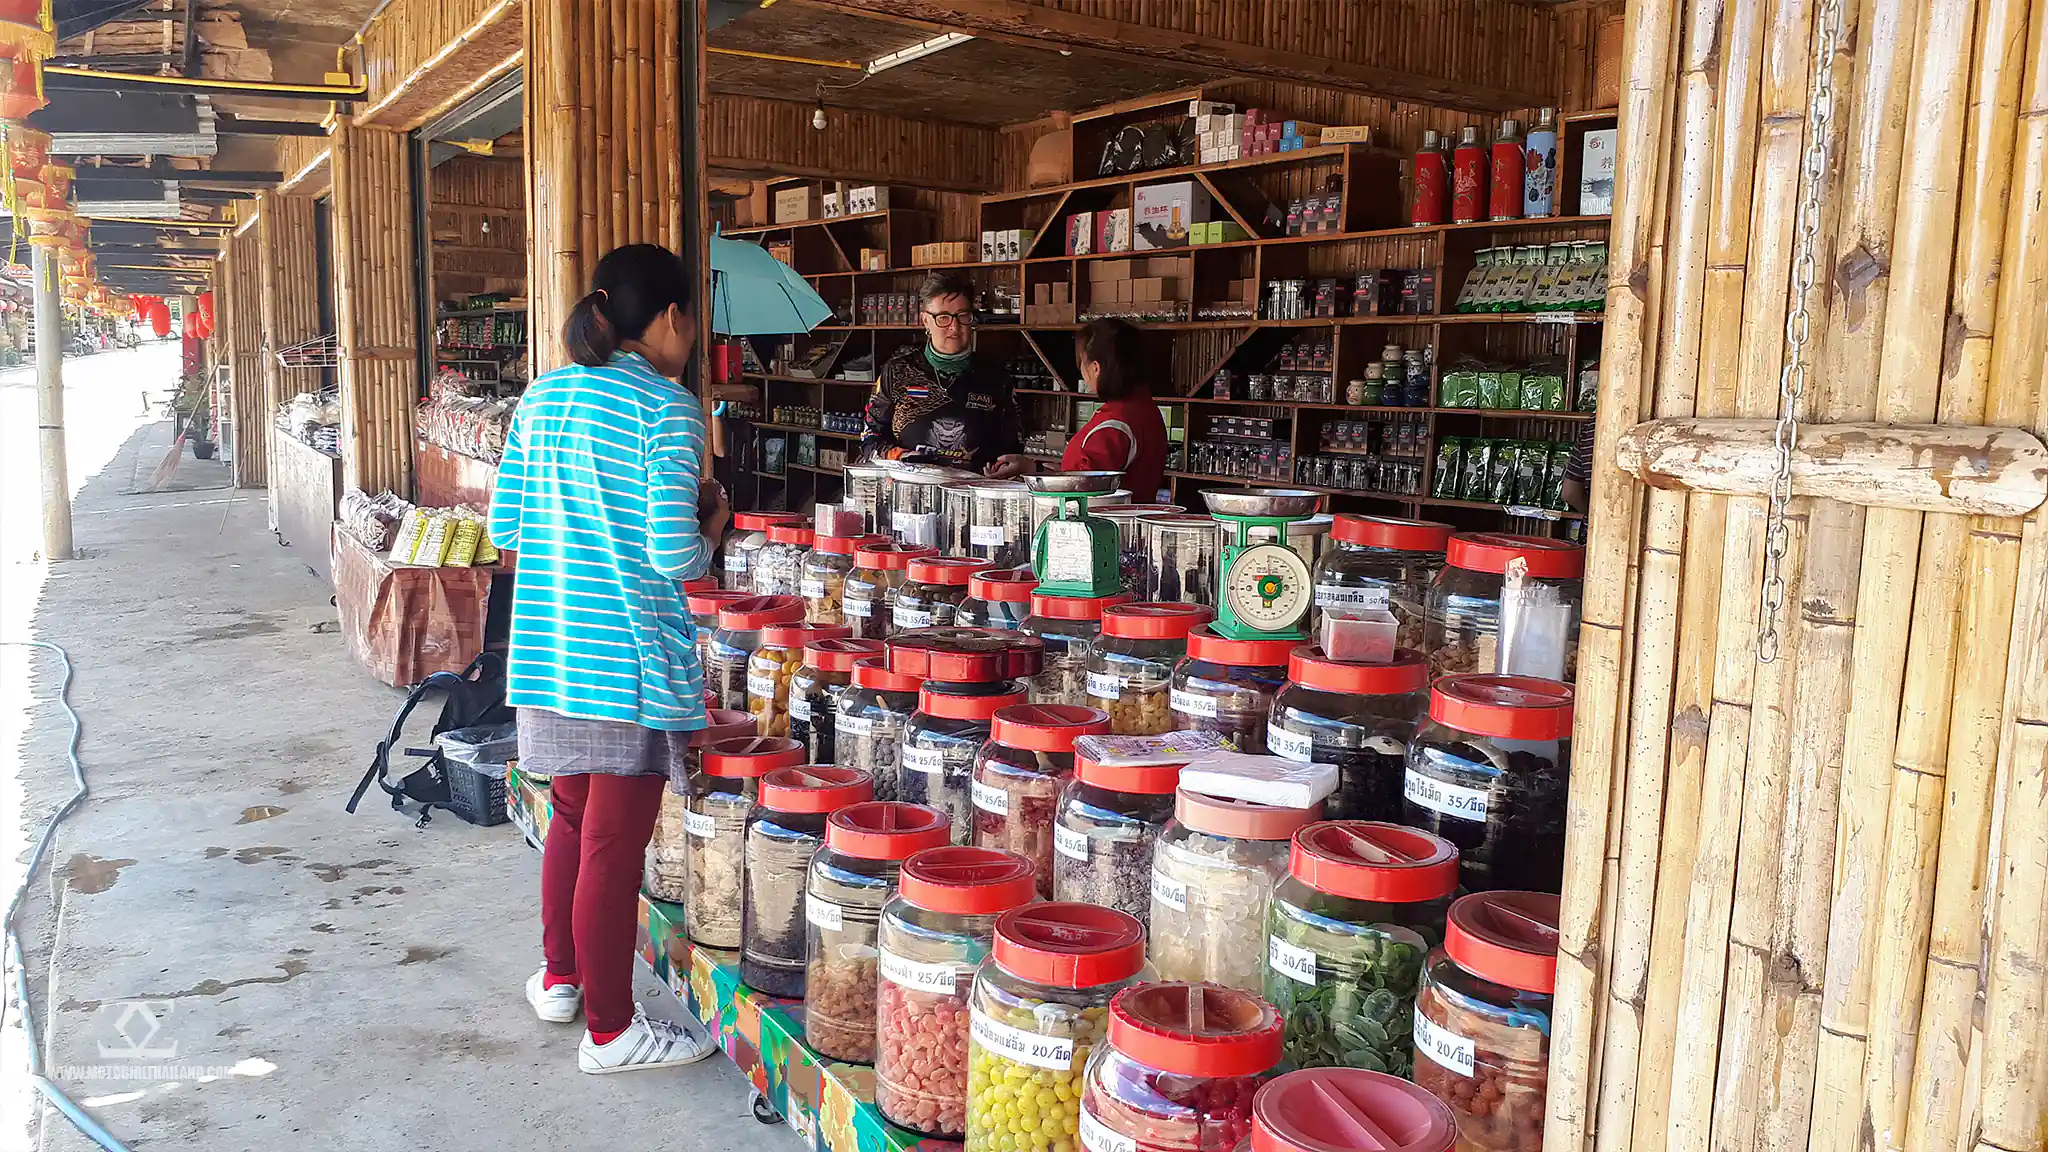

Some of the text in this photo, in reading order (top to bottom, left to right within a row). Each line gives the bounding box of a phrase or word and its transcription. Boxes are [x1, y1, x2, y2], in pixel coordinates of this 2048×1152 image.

[1284, 740, 1311, 756] 35/ขีด
[1448, 794, 1486, 813] 35/ขีด
[1282, 953, 1315, 976] 30/ขีด
[917, 970, 956, 986] 25/ขีด
[1031, 1044, 1071, 1061] 20/ขีด
[1436, 1040, 1473, 1068] 20/ขีด
